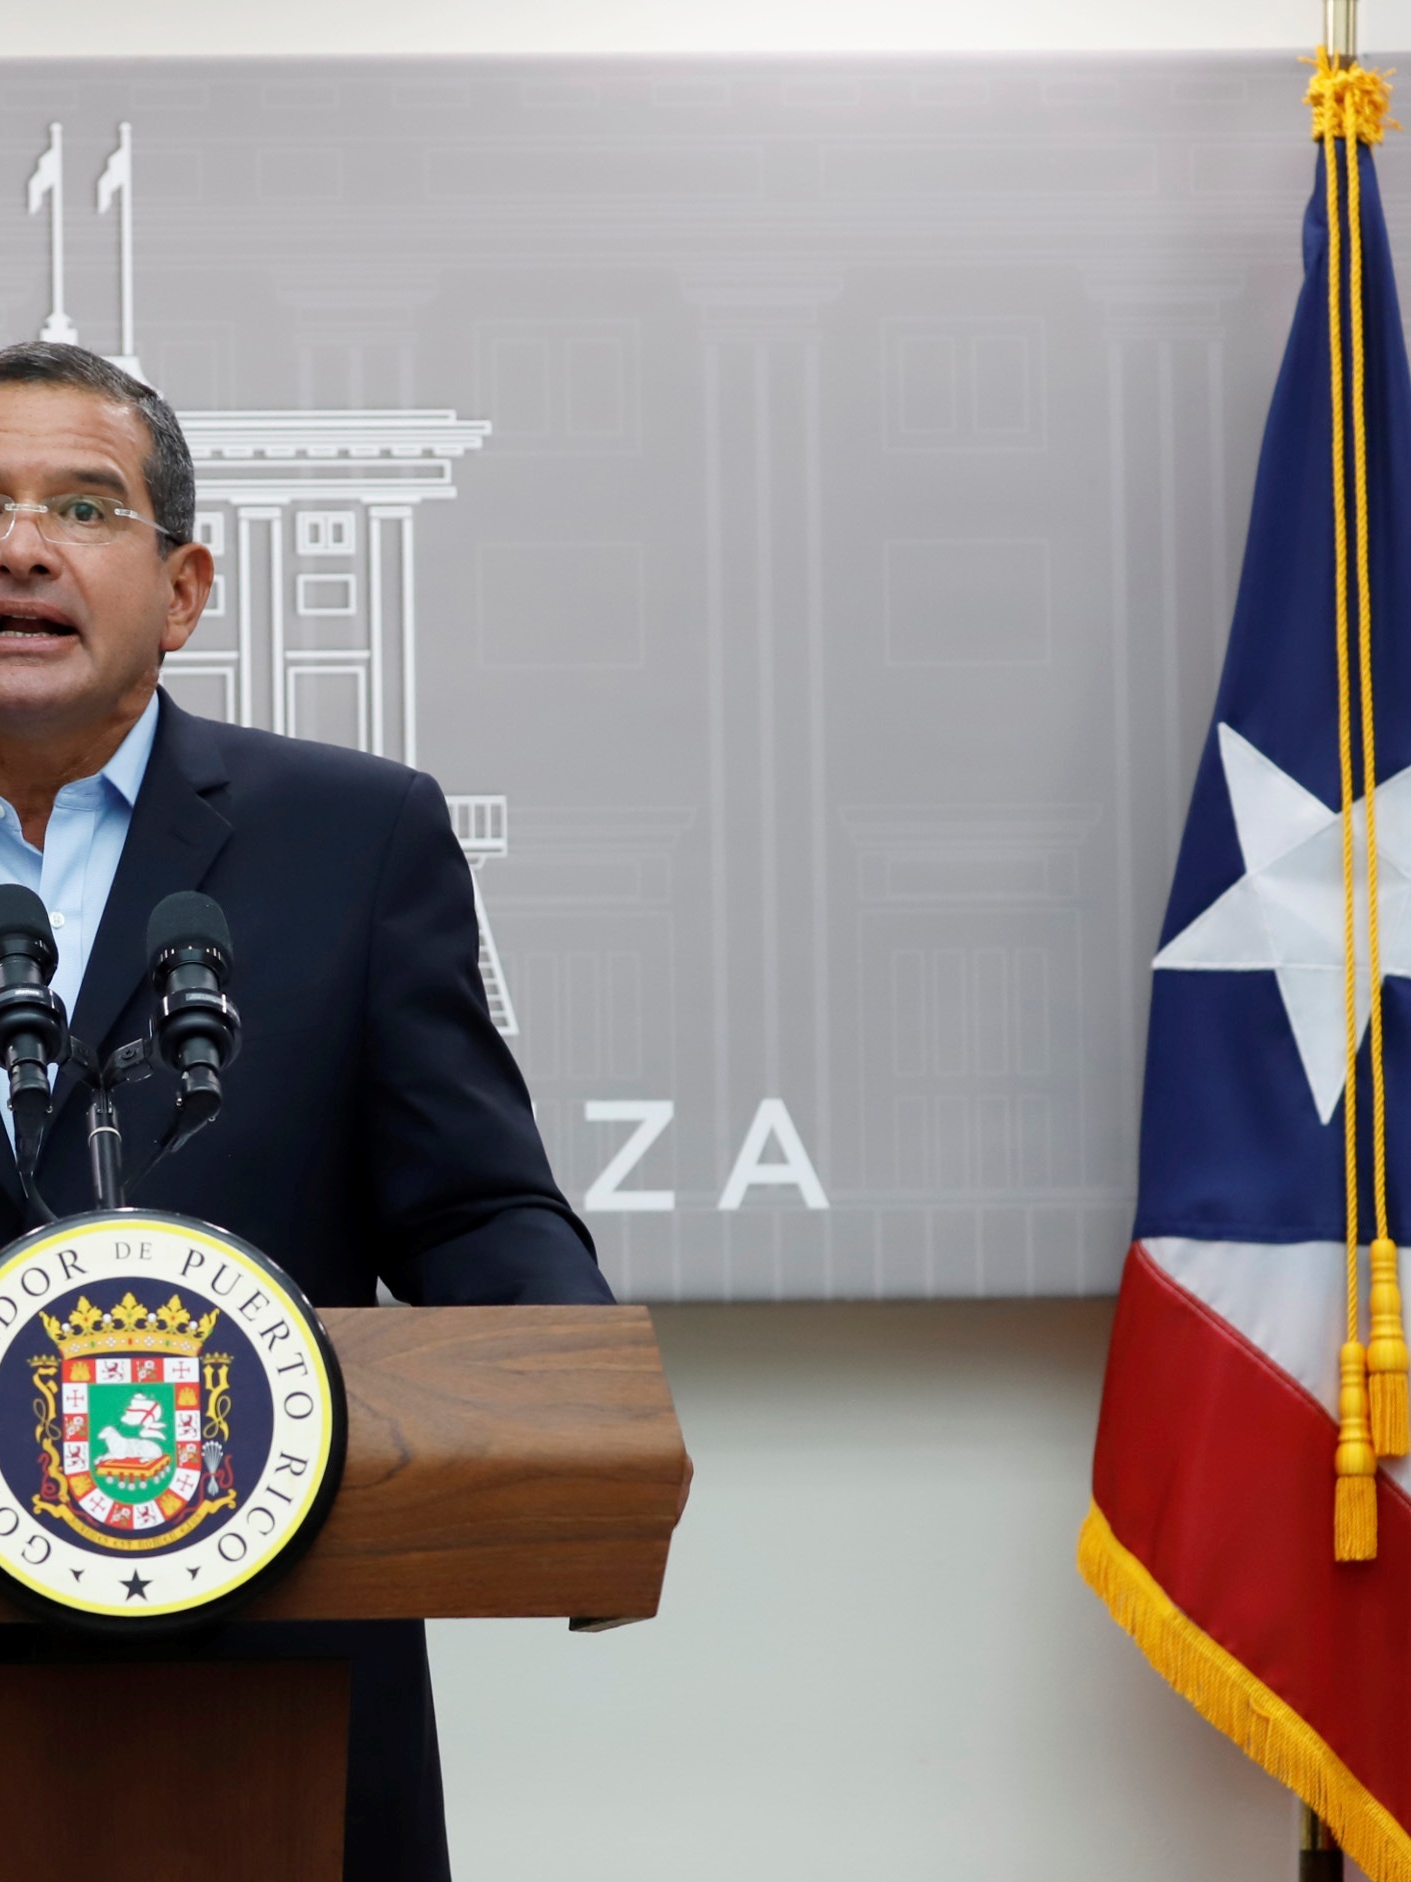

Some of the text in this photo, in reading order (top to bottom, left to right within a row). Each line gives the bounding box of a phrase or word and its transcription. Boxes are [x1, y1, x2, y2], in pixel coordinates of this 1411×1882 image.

[531, 1098, 830, 1211] ZA
[114, 1241, 153, 1261] DE
[179, 1248, 314, 1420] PUERTO
[218, 1451, 309, 1562] RICO
